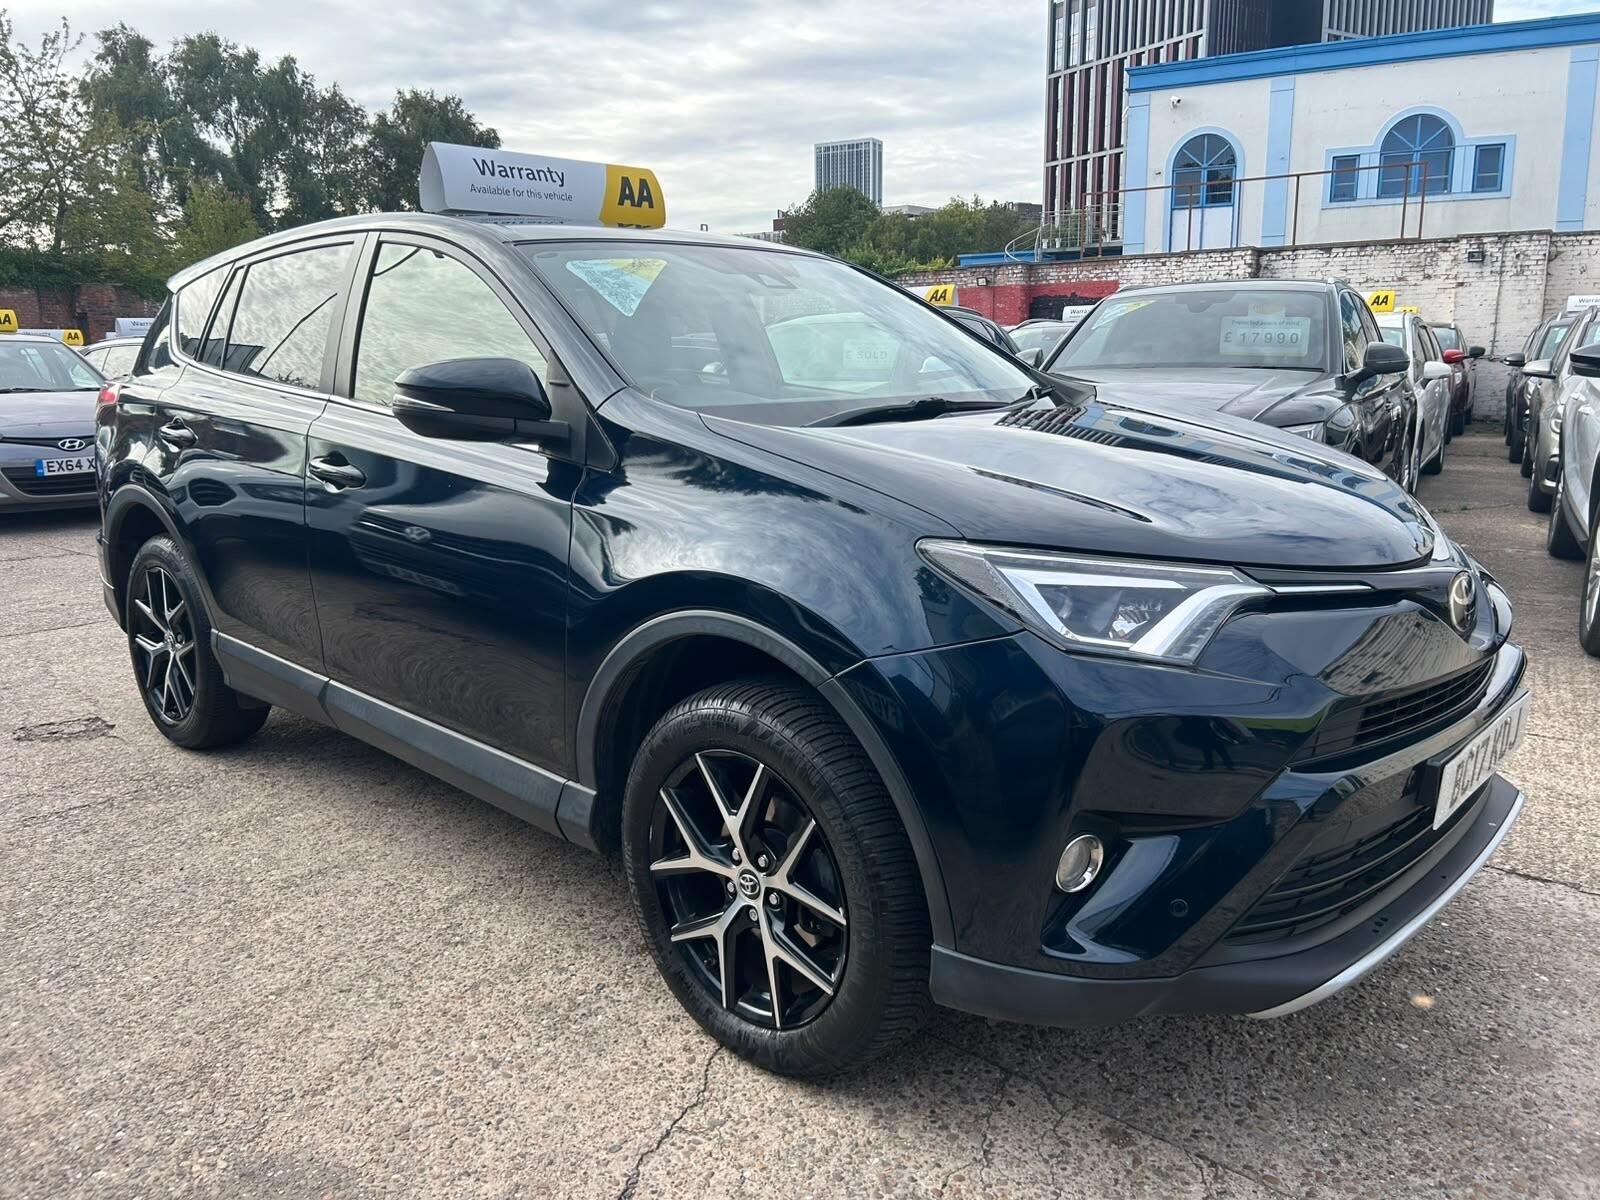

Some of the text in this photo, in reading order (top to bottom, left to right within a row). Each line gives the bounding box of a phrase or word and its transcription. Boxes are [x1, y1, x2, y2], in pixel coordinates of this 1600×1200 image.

[473, 157, 565, 187] Warranty
[470, 183, 573, 202] Available for this vehicle
[617, 176, 654, 209] AA
[929, 289, 947, 301] AA
[1371, 295, 1389, 306] AA
[67, 332, 79, 341] AA
[46, 459, 83, 473] EX64
